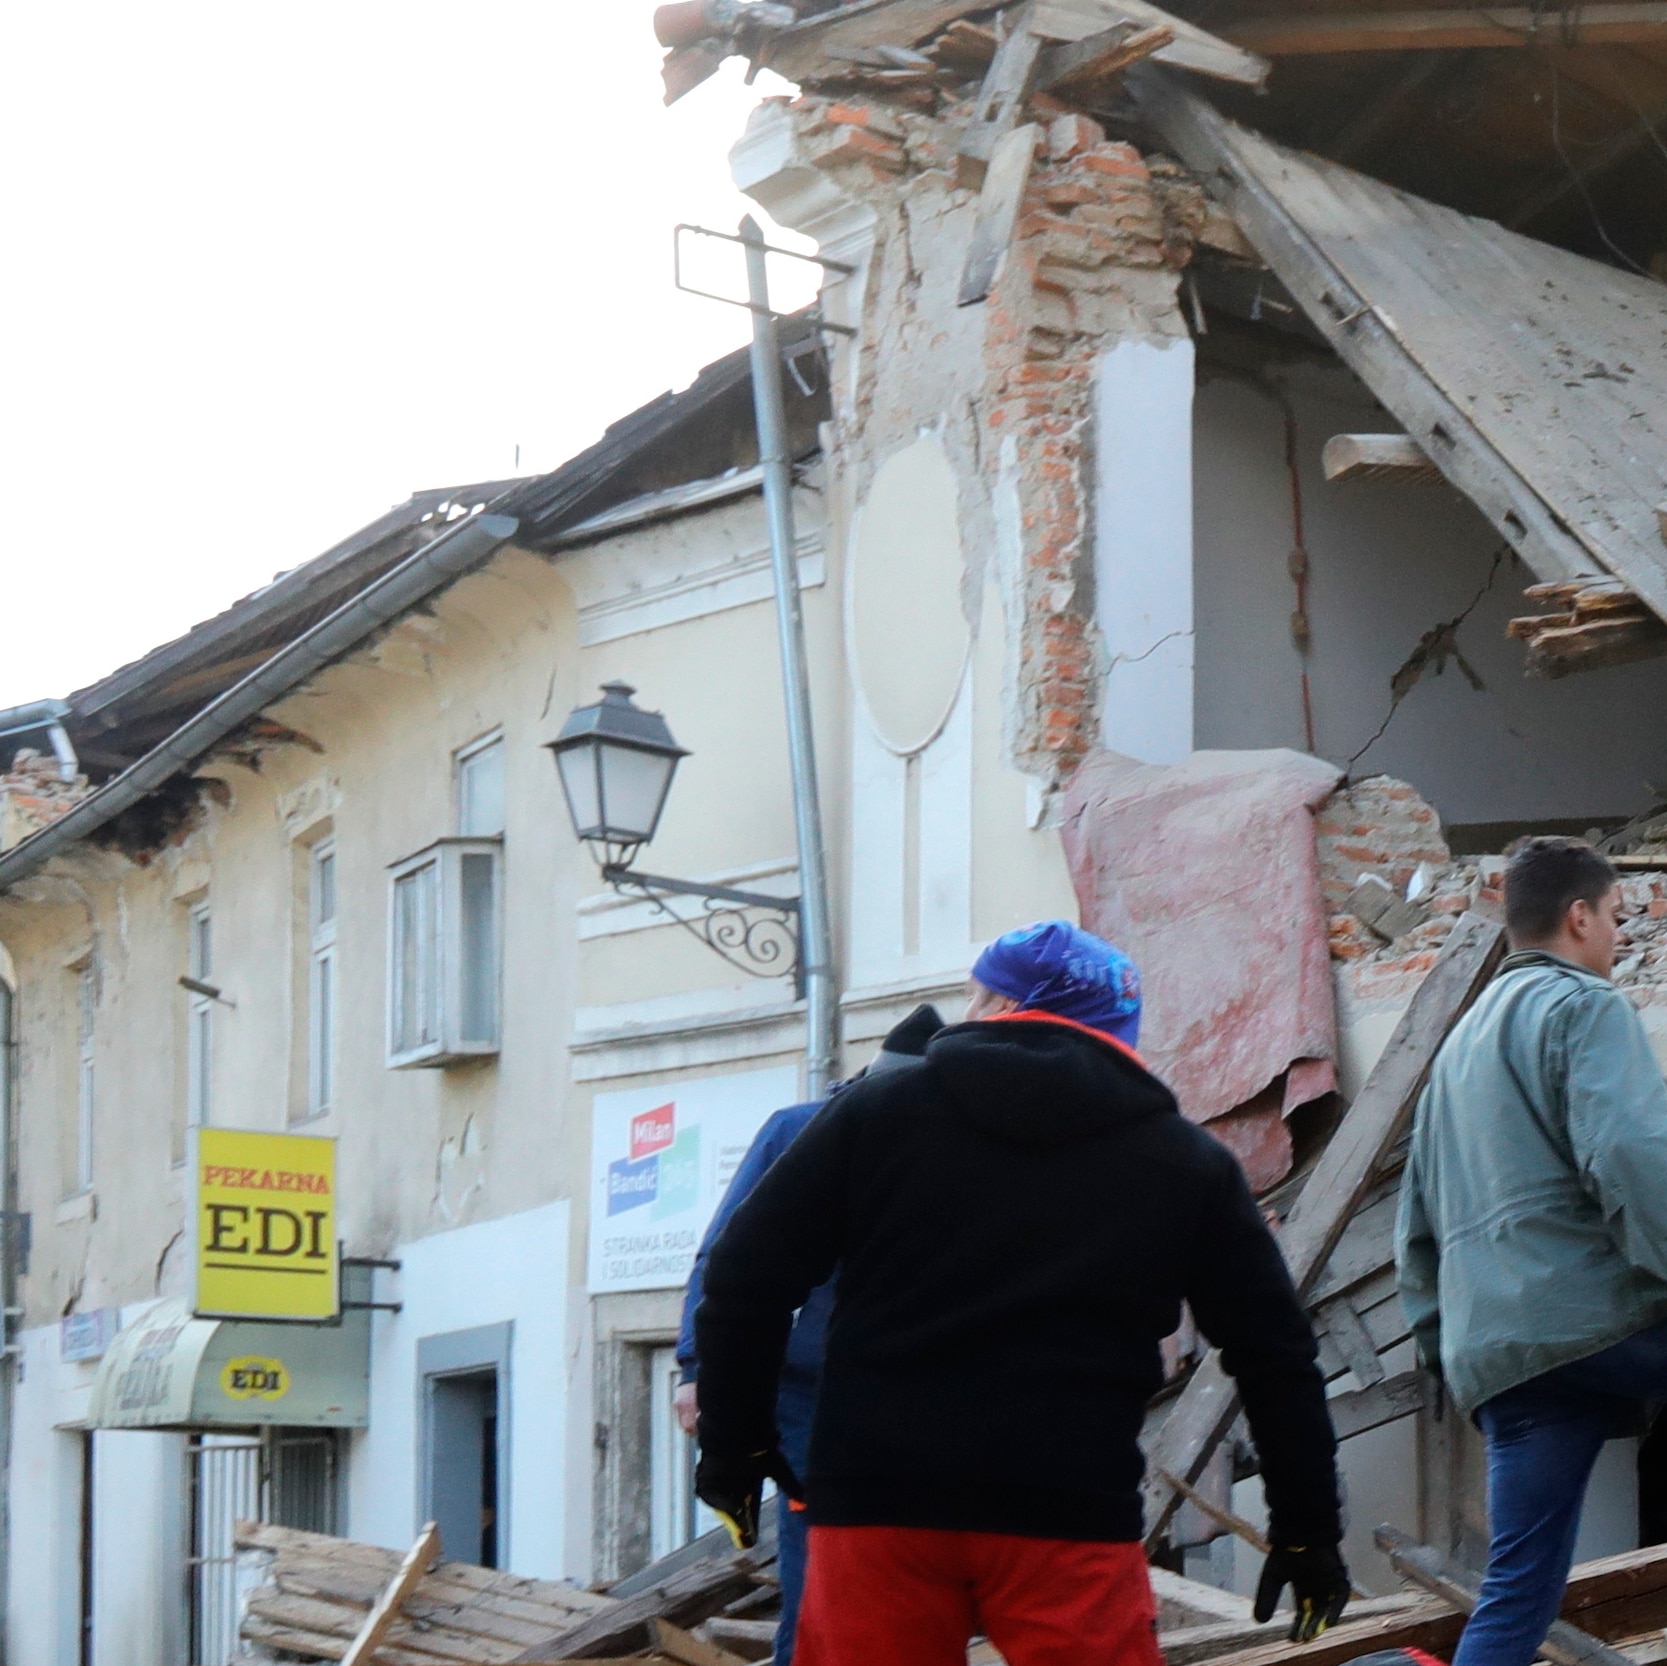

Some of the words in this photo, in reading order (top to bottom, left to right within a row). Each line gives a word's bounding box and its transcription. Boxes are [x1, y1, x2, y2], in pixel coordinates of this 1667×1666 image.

[634, 1120, 672, 1144] Milan
[204, 1165, 330, 1194] PEKARNA
[205, 1203, 327, 1259] EDI
[611, 1252, 694, 1280] SOLIDARNOST
[230, 1368, 281, 1390] EDI
